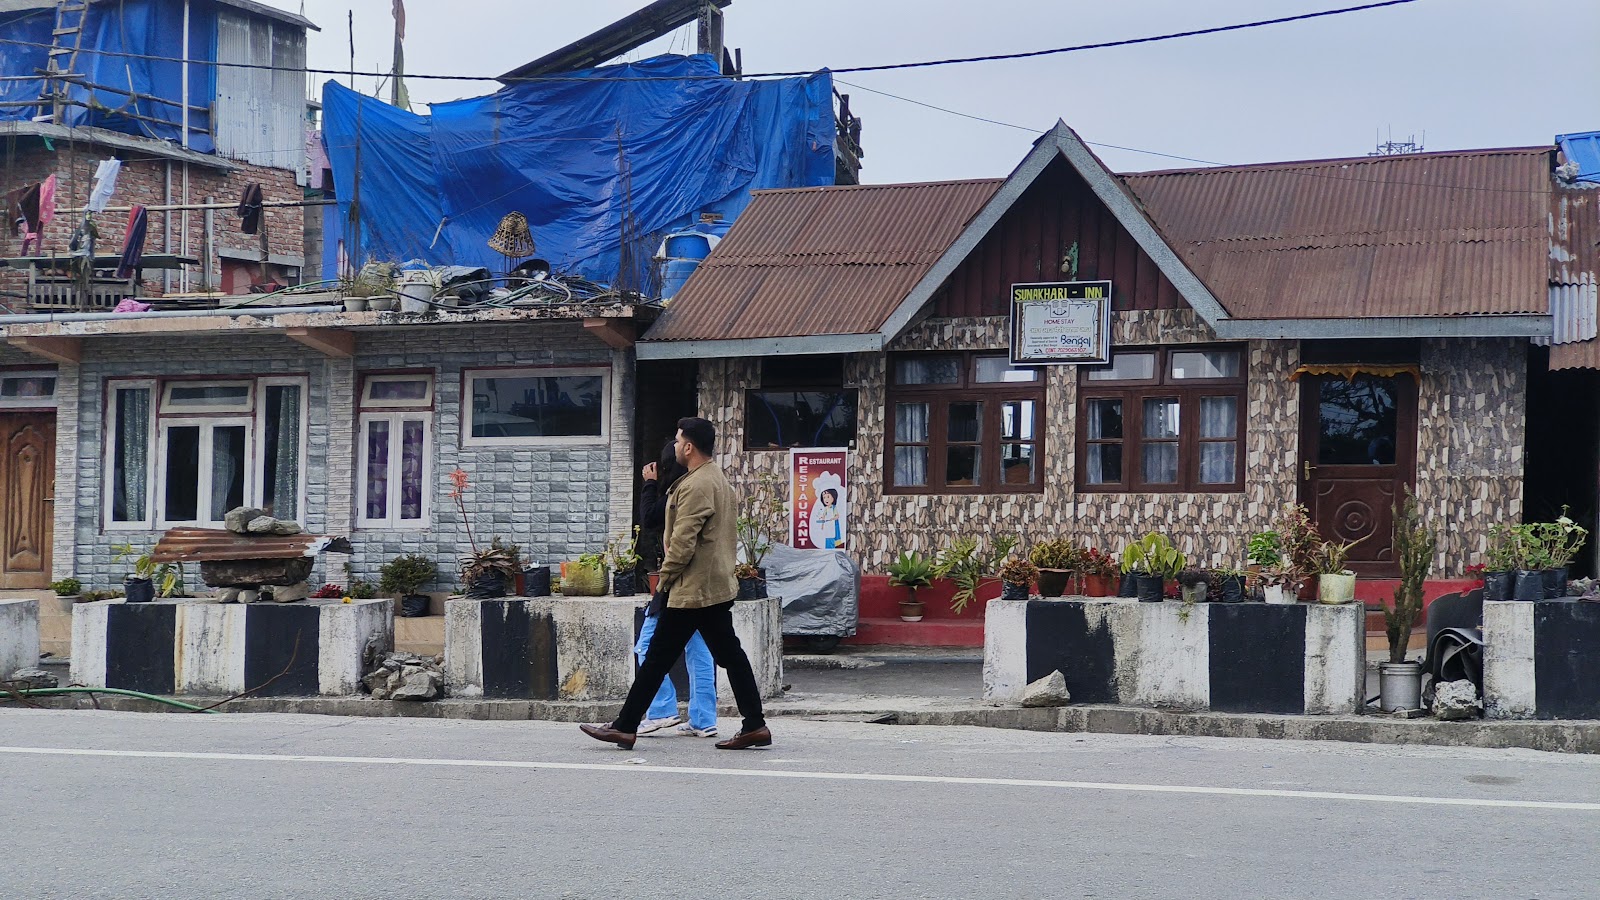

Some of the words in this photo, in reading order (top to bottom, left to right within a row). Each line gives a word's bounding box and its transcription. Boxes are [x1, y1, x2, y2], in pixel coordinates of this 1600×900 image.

[1014, 287, 1068, 301] SUNAKHARI
[1085, 287, 1102, 299] INN
[1060, 334, 1091, 348] Bengal
[798, 456, 809, 546] RESTAURANT
